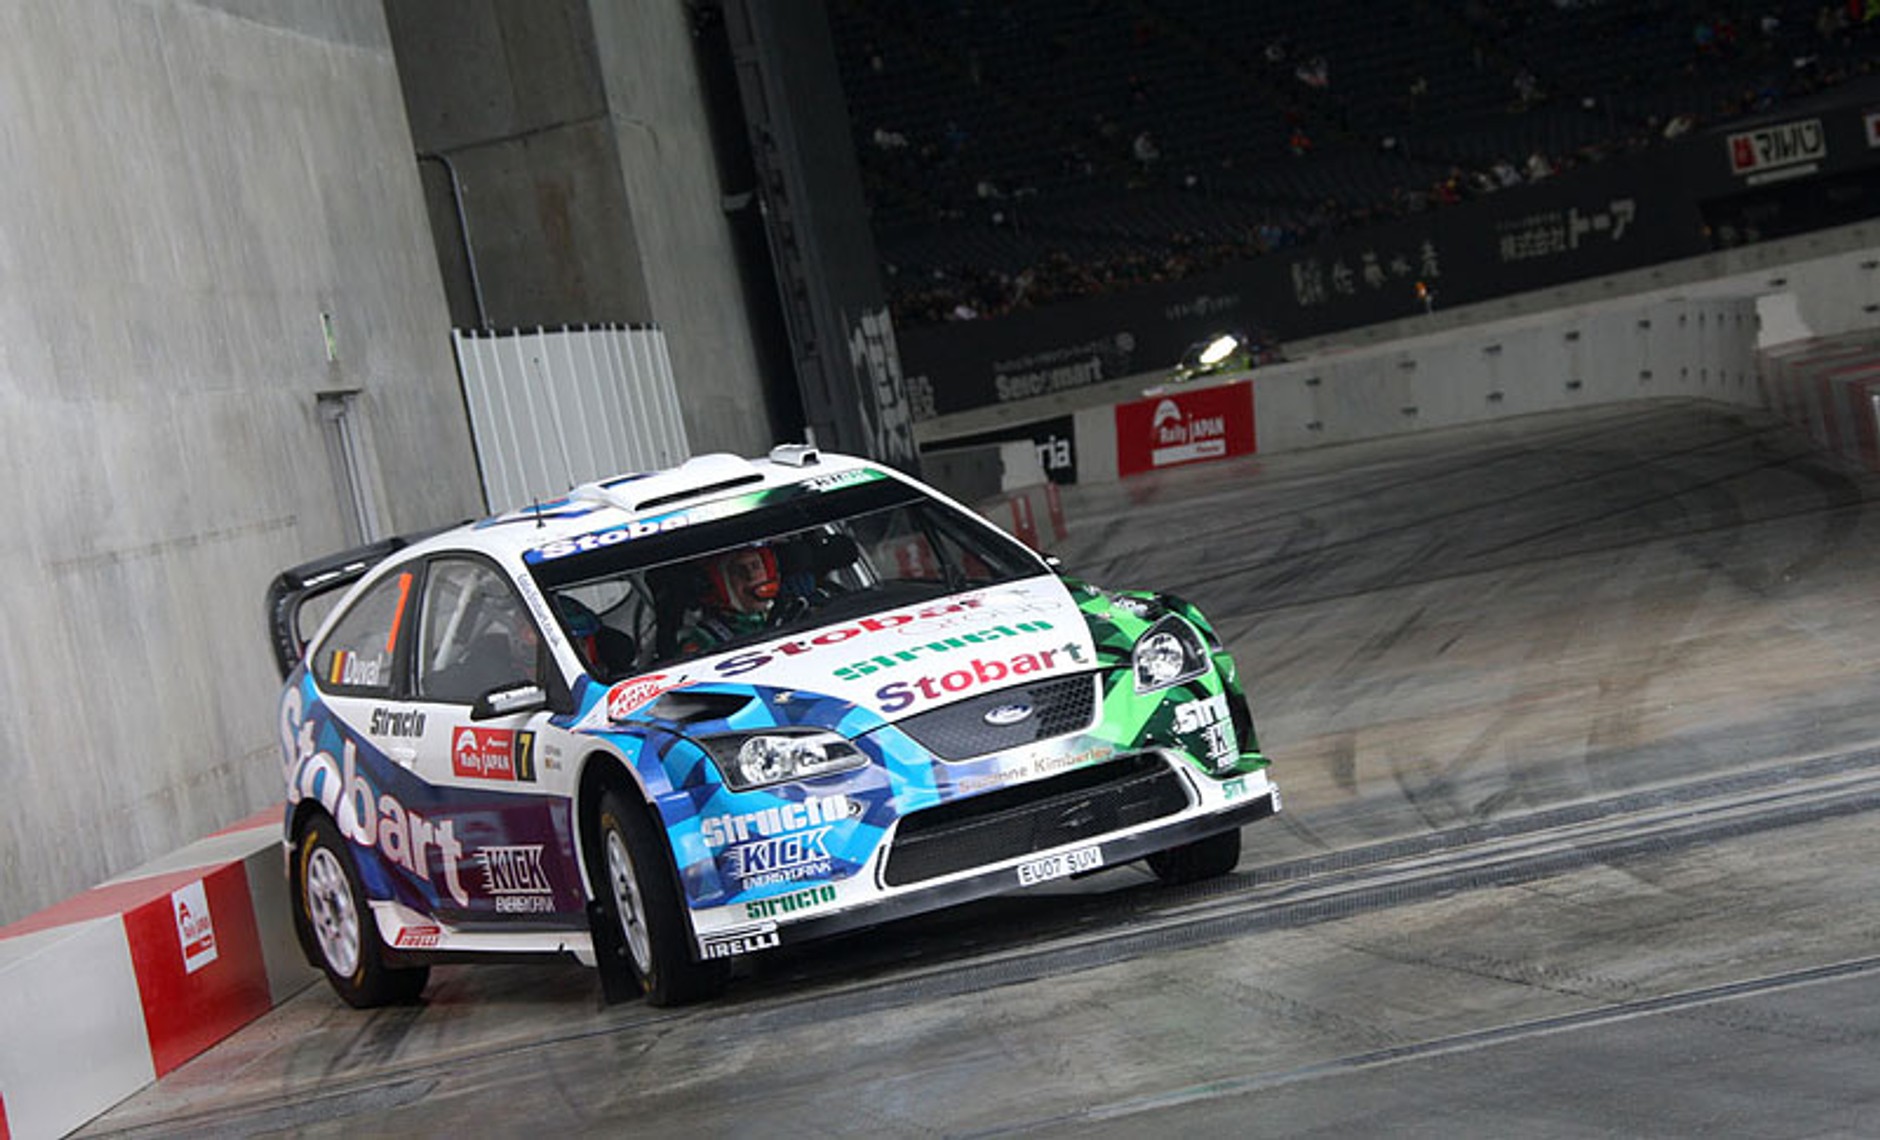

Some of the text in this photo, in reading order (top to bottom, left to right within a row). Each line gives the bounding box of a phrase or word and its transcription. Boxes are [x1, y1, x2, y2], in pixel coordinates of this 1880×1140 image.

[876, 642, 1089, 713] Stobart
[520, 733, 532, 778] 7
[281, 685, 469, 909] Stobart
[740, 828, 830, 874] KICK
[1021, 848, 1098, 883] EU07 SUV
